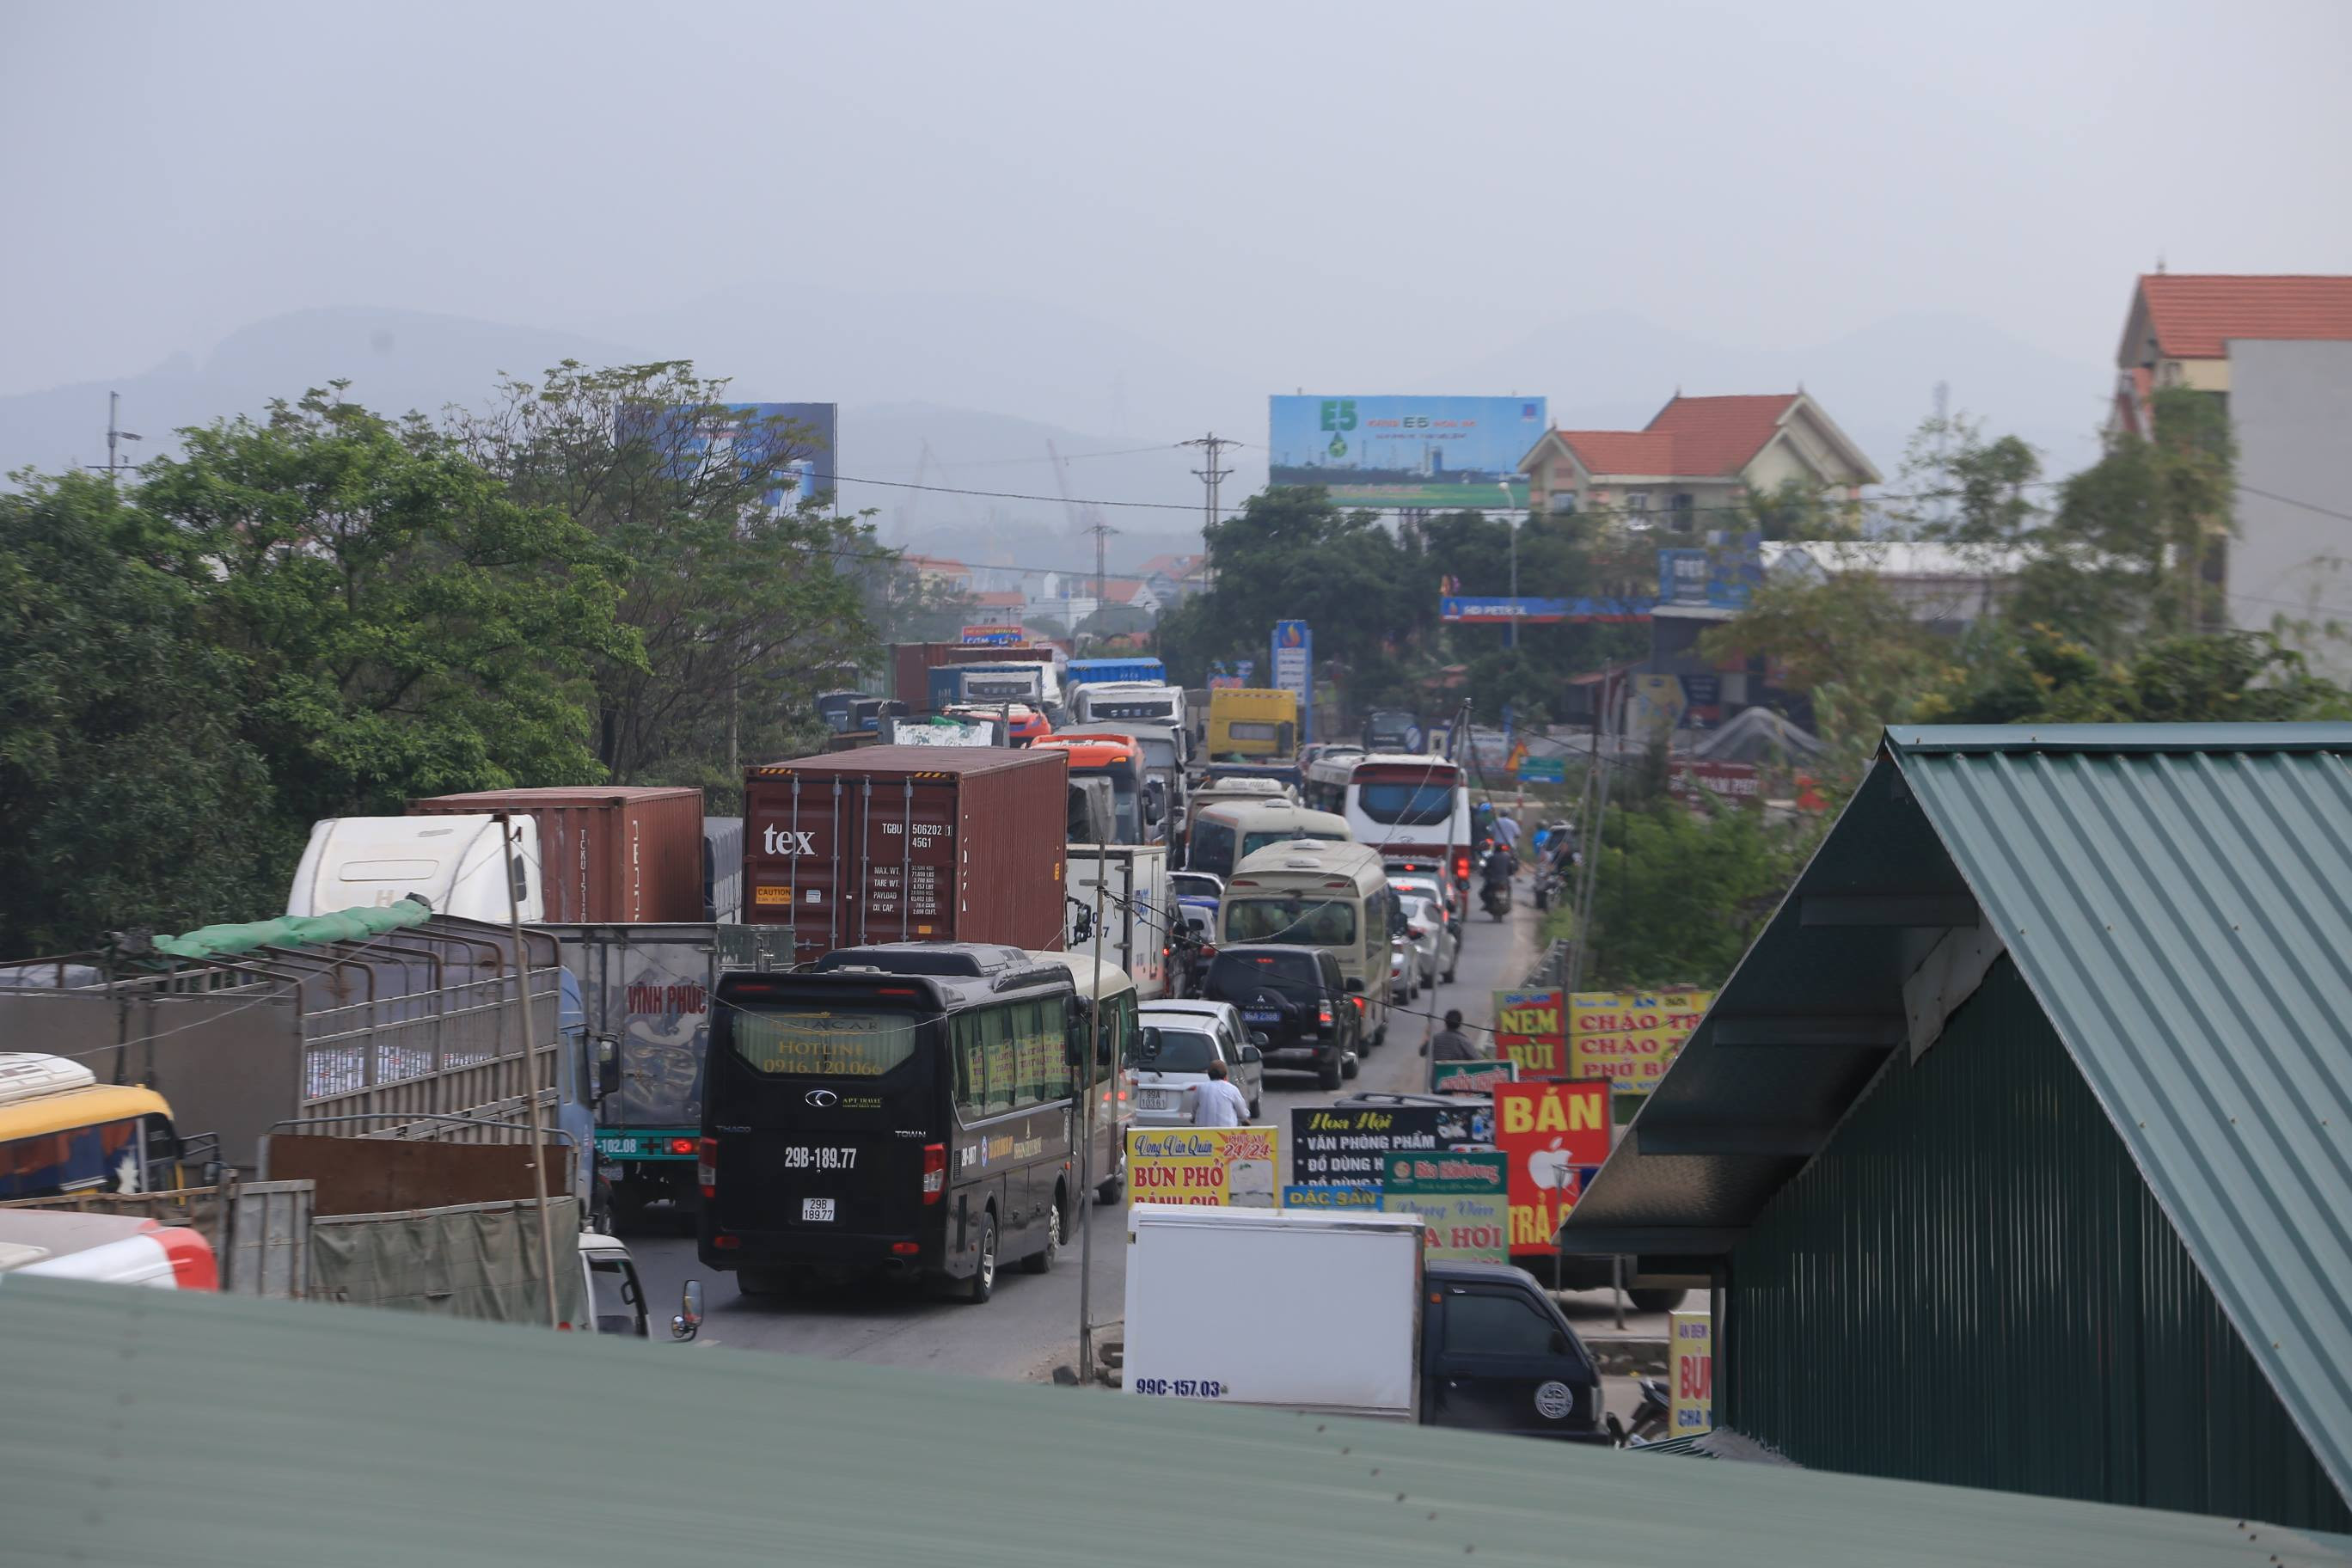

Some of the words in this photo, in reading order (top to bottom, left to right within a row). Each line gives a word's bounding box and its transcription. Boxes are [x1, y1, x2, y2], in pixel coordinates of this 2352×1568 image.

[1320, 401, 1357, 431] E5
[1402, 416, 1429, 429] E5
[882, 823, 903, 835] TGBU
[912, 824, 942, 836] 506202
[763, 823, 816, 856] tex
[912, 837, 932, 848] 45G1
[757, 887, 791, 896] CAUTION
[1499, 1008, 1558, 1035] NEM
[779, 1042, 866, 1056] HOTLINE
[1504, 1087, 1603, 1135] BÁN
[715, 1125, 752, 1134] THACO
[1308, 1134, 1337, 1150] VĂN
[1340, 1133, 1389, 1149] PHÒNG
[784, 1147, 857, 1169] 29B-189.77
[1223, 1143, 1271, 1158] 24/24
[1308, 1154, 1326, 1172] ĐỒ
[1331, 1155, 1371, 1171] DÙNG
[1134, 1161, 1177, 1187] BÚN
[1183, 1158, 1224, 1187] PHỞ
[810, 1200, 827, 1210] 29B
[1136, 1378, 1220, 1398] 99C-157.03
